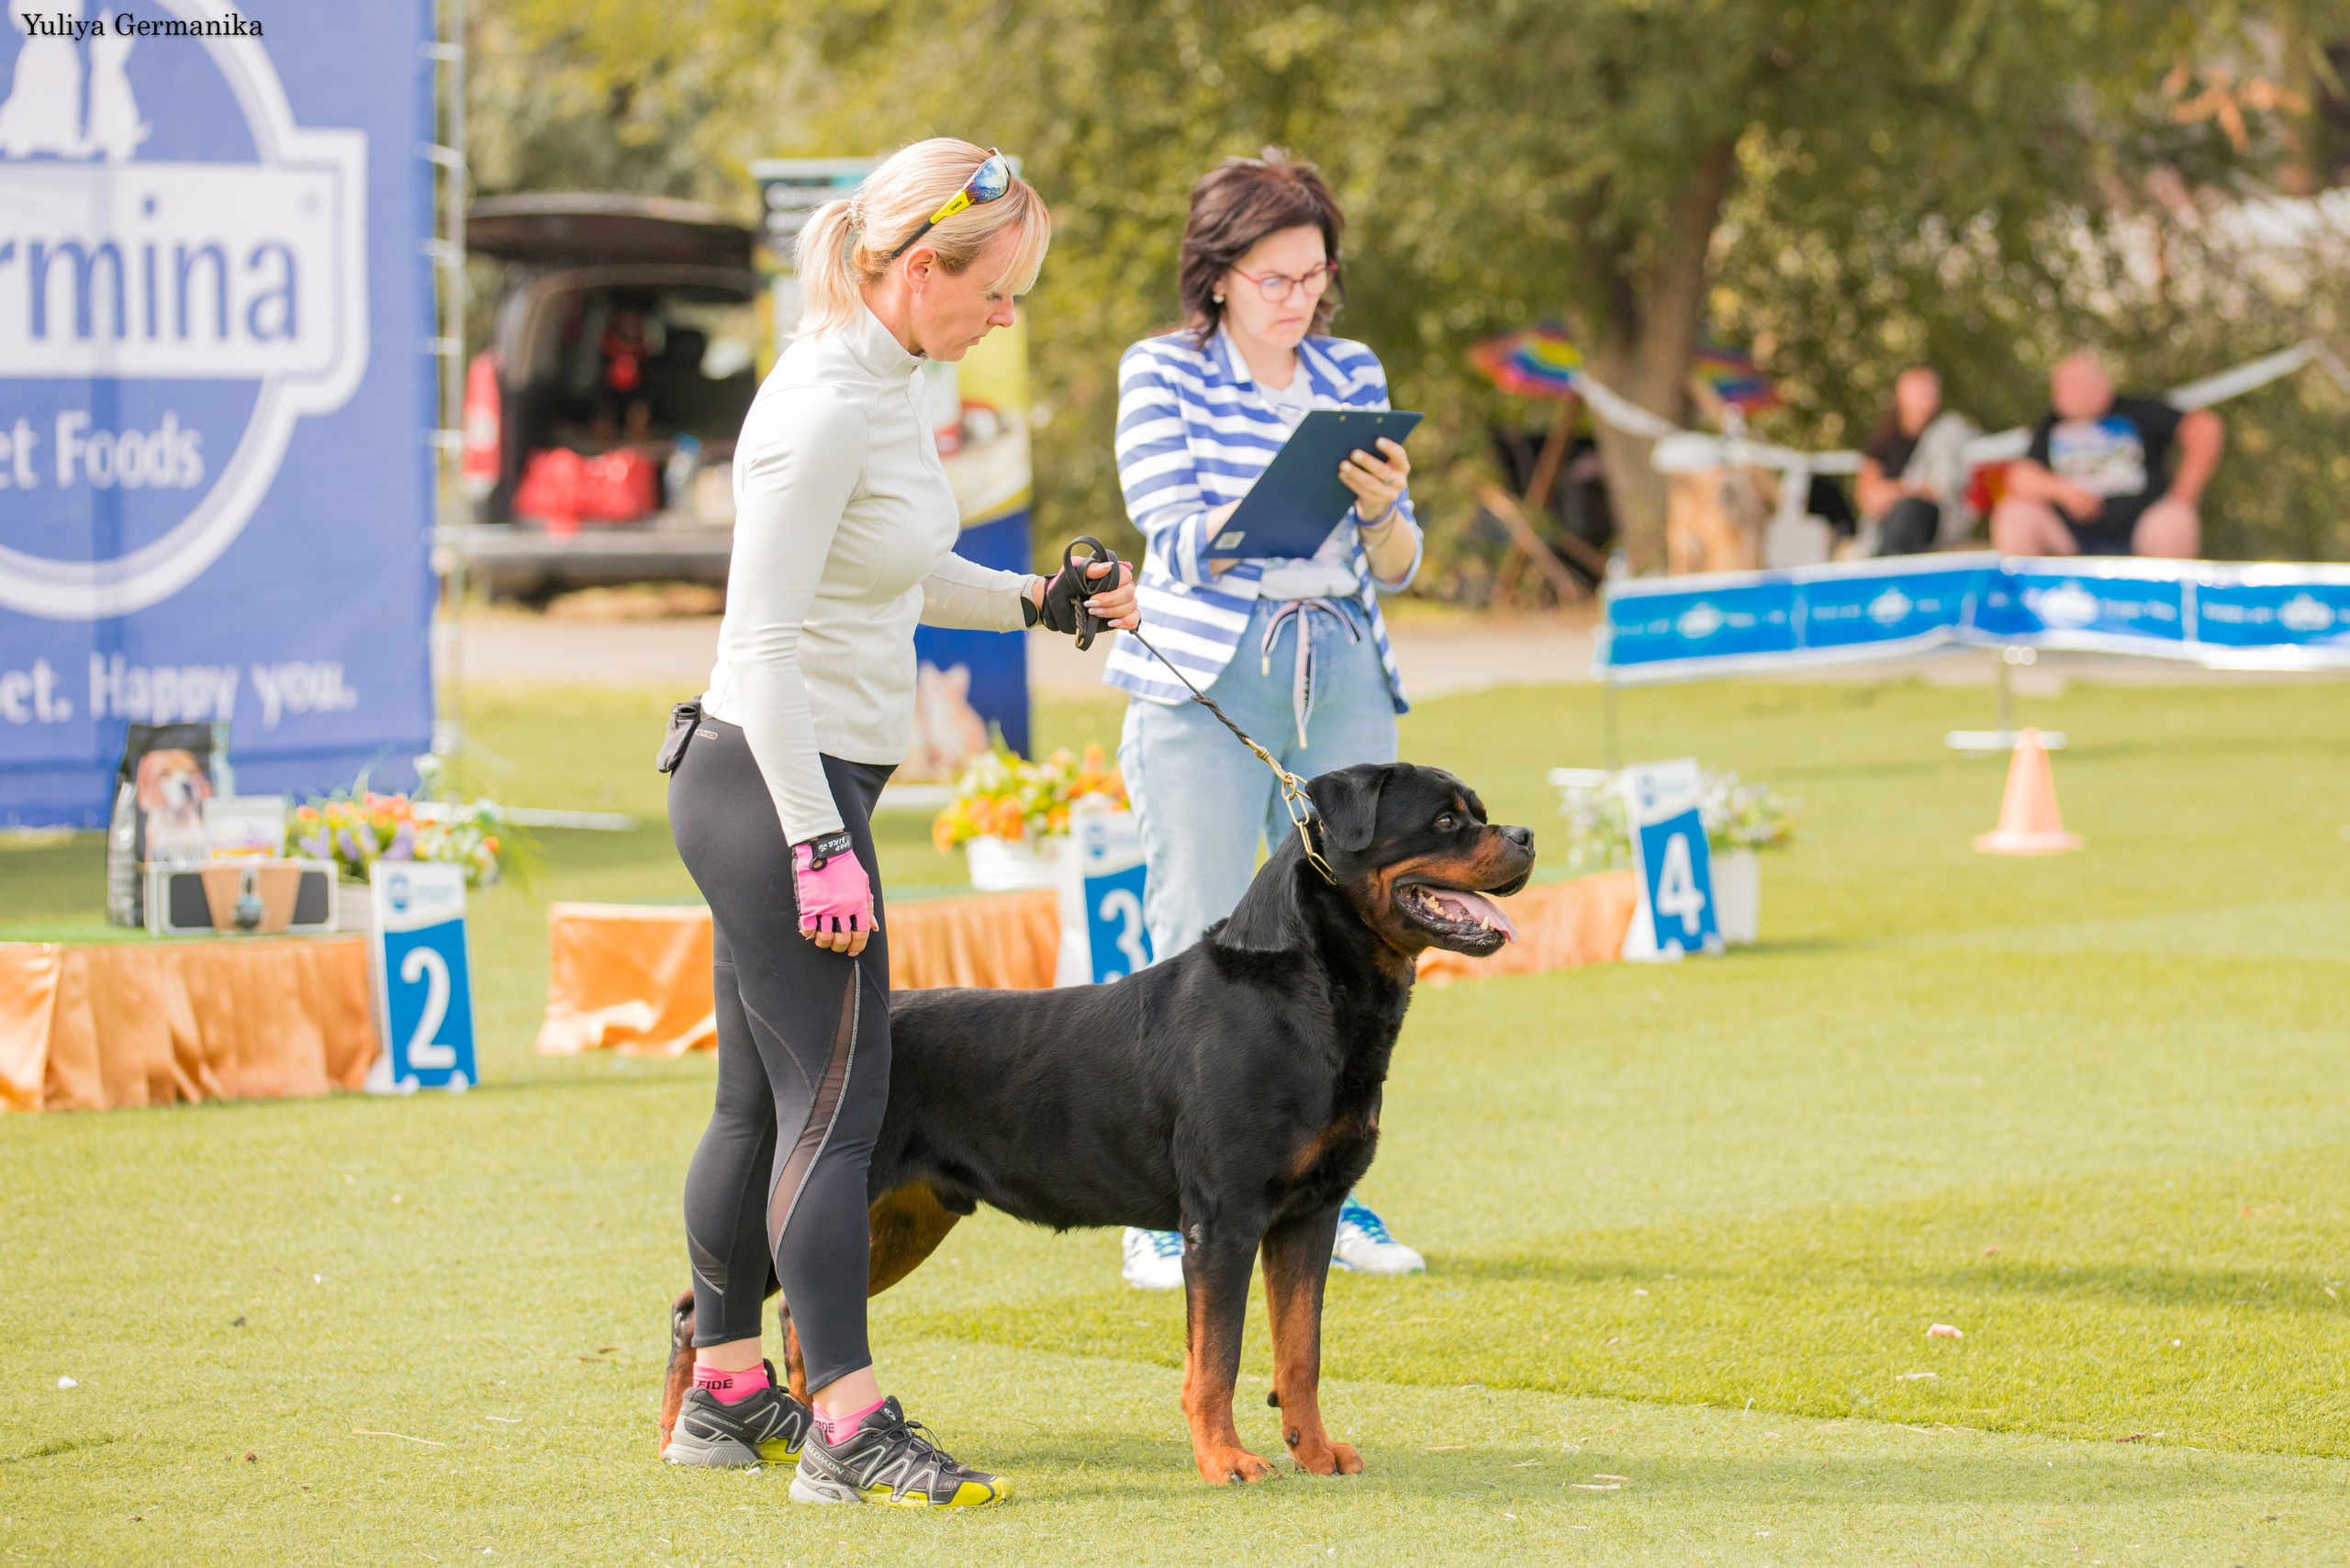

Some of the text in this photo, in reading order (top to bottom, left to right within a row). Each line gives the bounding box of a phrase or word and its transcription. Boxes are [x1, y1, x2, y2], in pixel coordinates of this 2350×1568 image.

[0, 196, 298, 342] mina
[55, 409, 206, 490] Foods
[0, 650, 360, 733] et. Happy you.
[1655, 832, 1707, 937] 4
[1098, 888, 1149, 986] 3
[399, 946, 458, 1070] 2
[697, 1378, 733, 1390] FIDE
